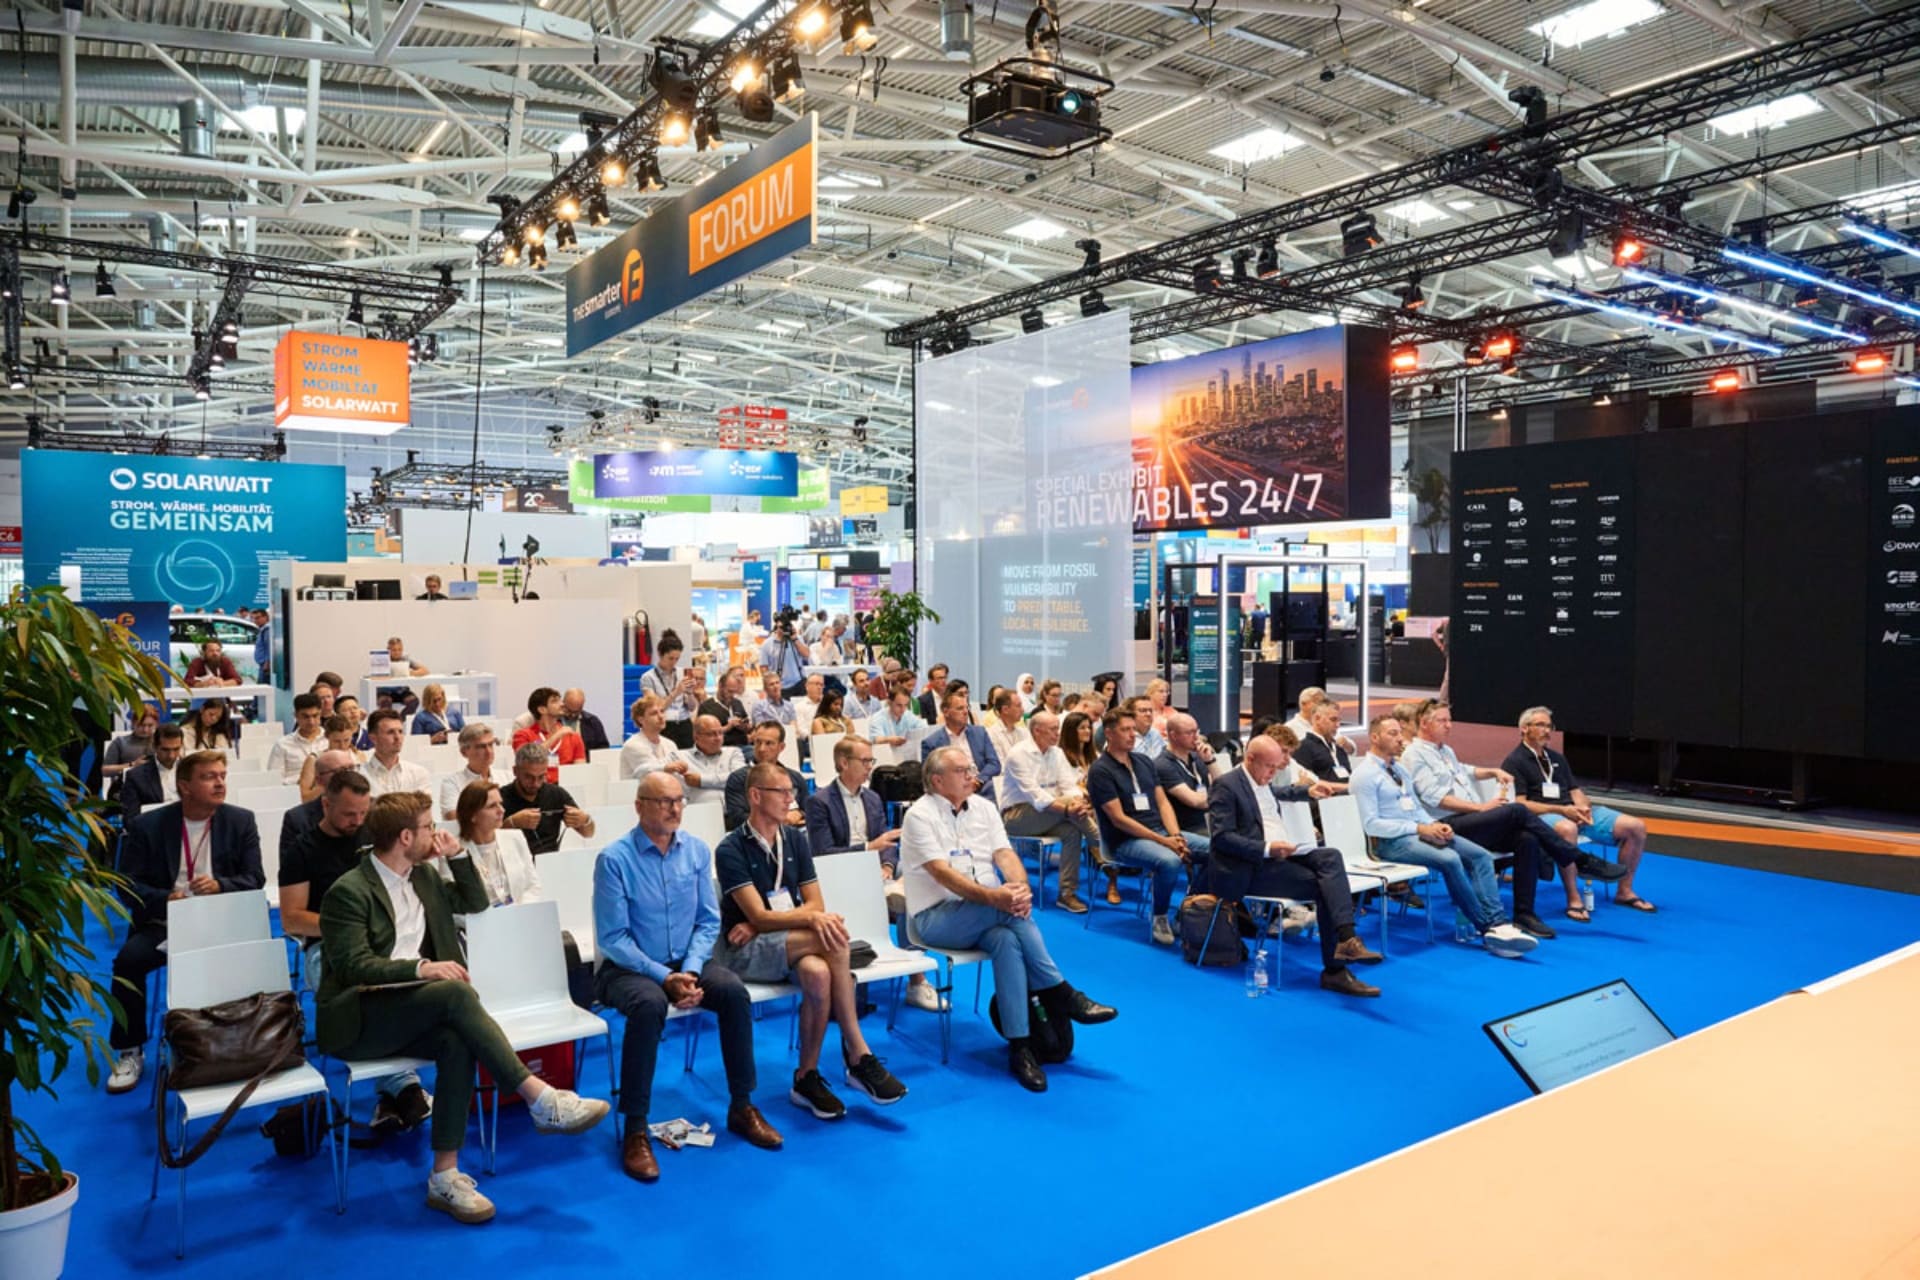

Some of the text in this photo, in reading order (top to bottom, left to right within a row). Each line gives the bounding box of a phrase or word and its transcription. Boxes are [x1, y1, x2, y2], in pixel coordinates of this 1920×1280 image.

[698, 164, 795, 263] FORUM
[302, 342, 358, 358] STROM
[302, 394, 399, 414] SOLARWATT
[142, 472, 273, 494] SOLARWATT
[1034, 464, 1165, 498] SPECIAL EXHIBIT
[111, 500, 275, 514] STROM. WÄRME. MOBILITÄT.
[1037, 472, 1322, 530] RENEWABLES 24/7
[110, 511, 273, 533] GEMEINSAM
[1003, 562, 1099, 578] MOVE FROM FOSSIL
[1003, 582, 1078, 596] VULNERABILITY
